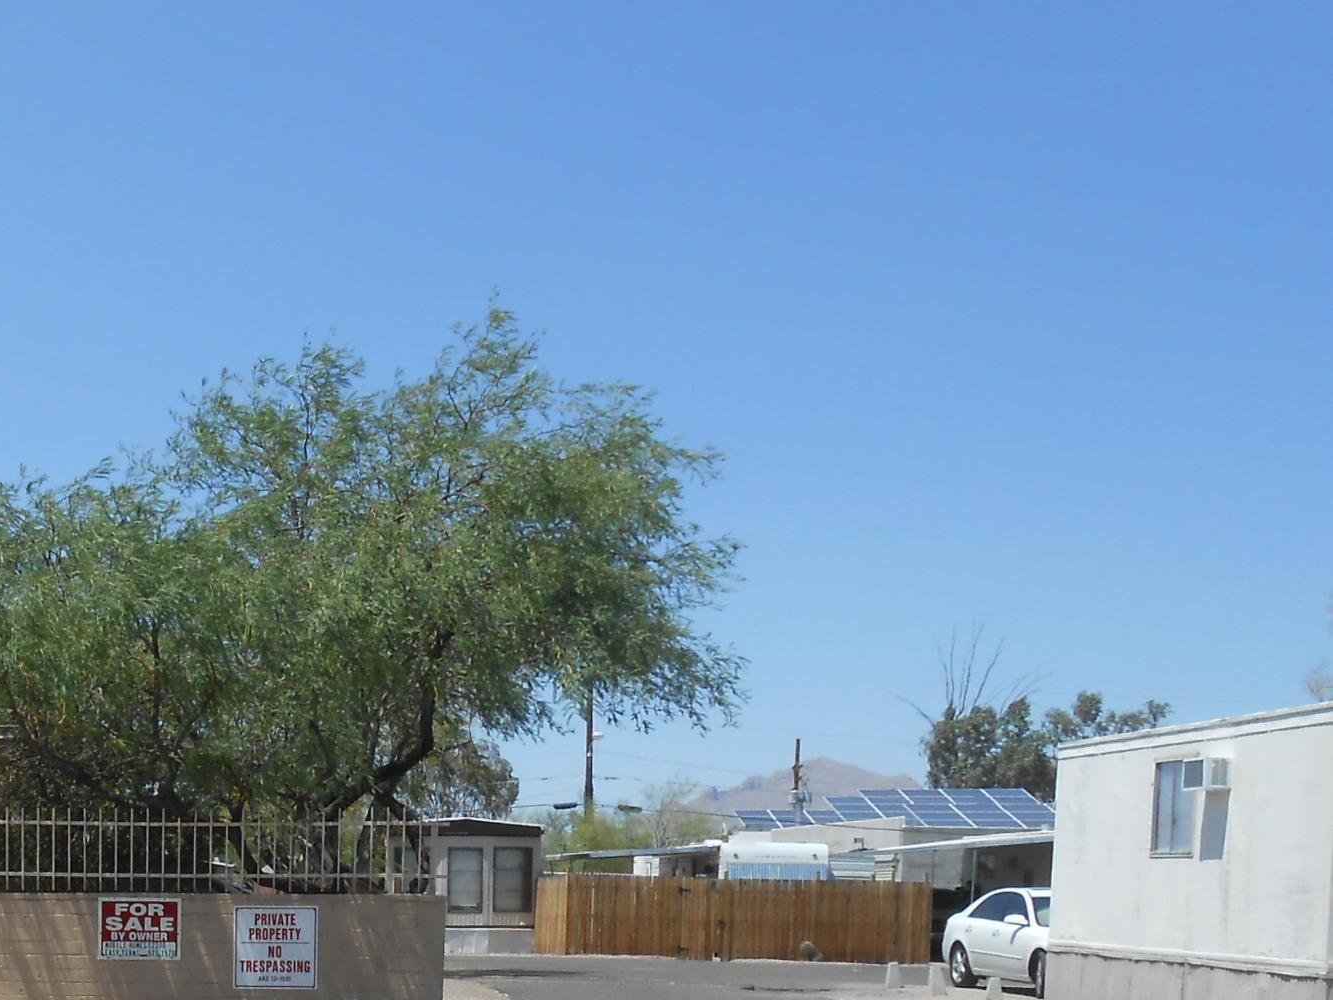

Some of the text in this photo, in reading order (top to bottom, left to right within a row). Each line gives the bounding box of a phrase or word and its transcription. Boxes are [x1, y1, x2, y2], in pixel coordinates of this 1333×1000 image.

[114, 903, 164, 916] FOR
[105, 916, 174, 931] SALE
[254, 913, 296, 926] PRIVATE
[111, 931, 168, 941] BY OWNER
[248, 928, 301, 940] PROPERTY
[268, 945, 282, 958] NO
[239, 960, 311, 973] TRESPASSING
